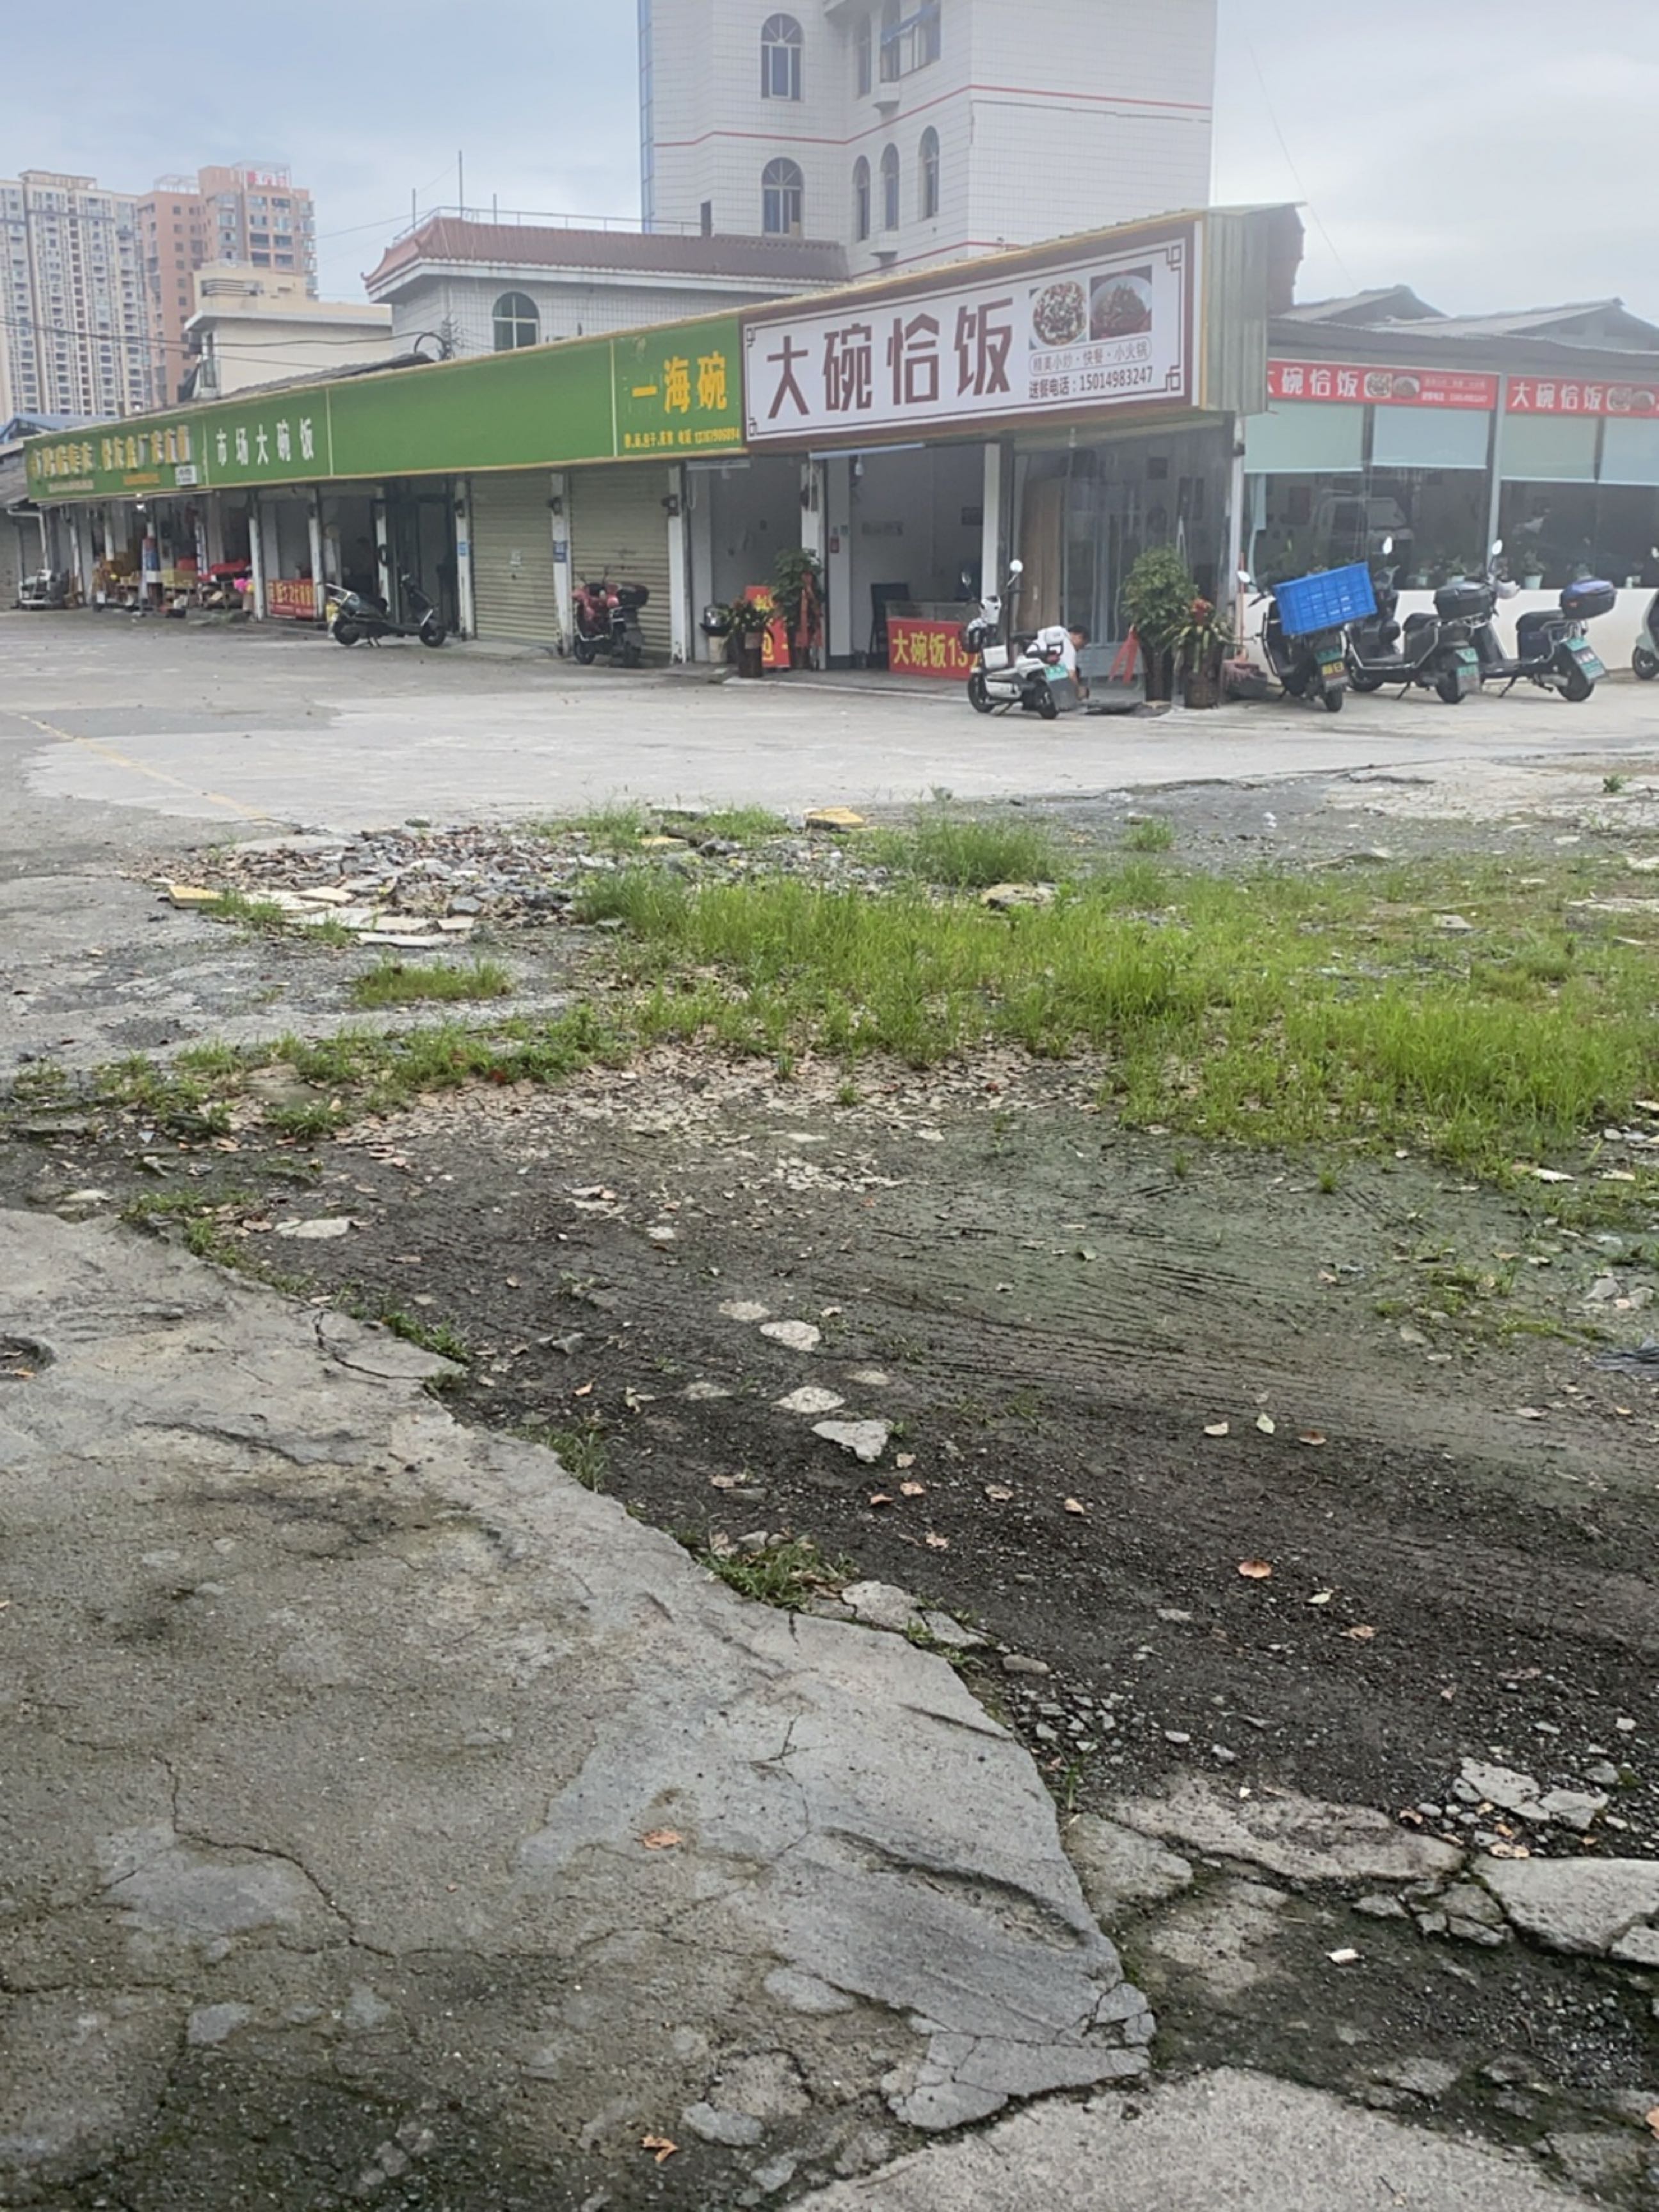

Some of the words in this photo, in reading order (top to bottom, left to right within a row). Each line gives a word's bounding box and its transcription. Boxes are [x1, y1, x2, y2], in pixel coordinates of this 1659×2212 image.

[631, 351, 727, 414] 一海碗
[766, 296, 1013, 419] 大碗恰饭
[216, 417, 314, 467] 市场大碗饭
